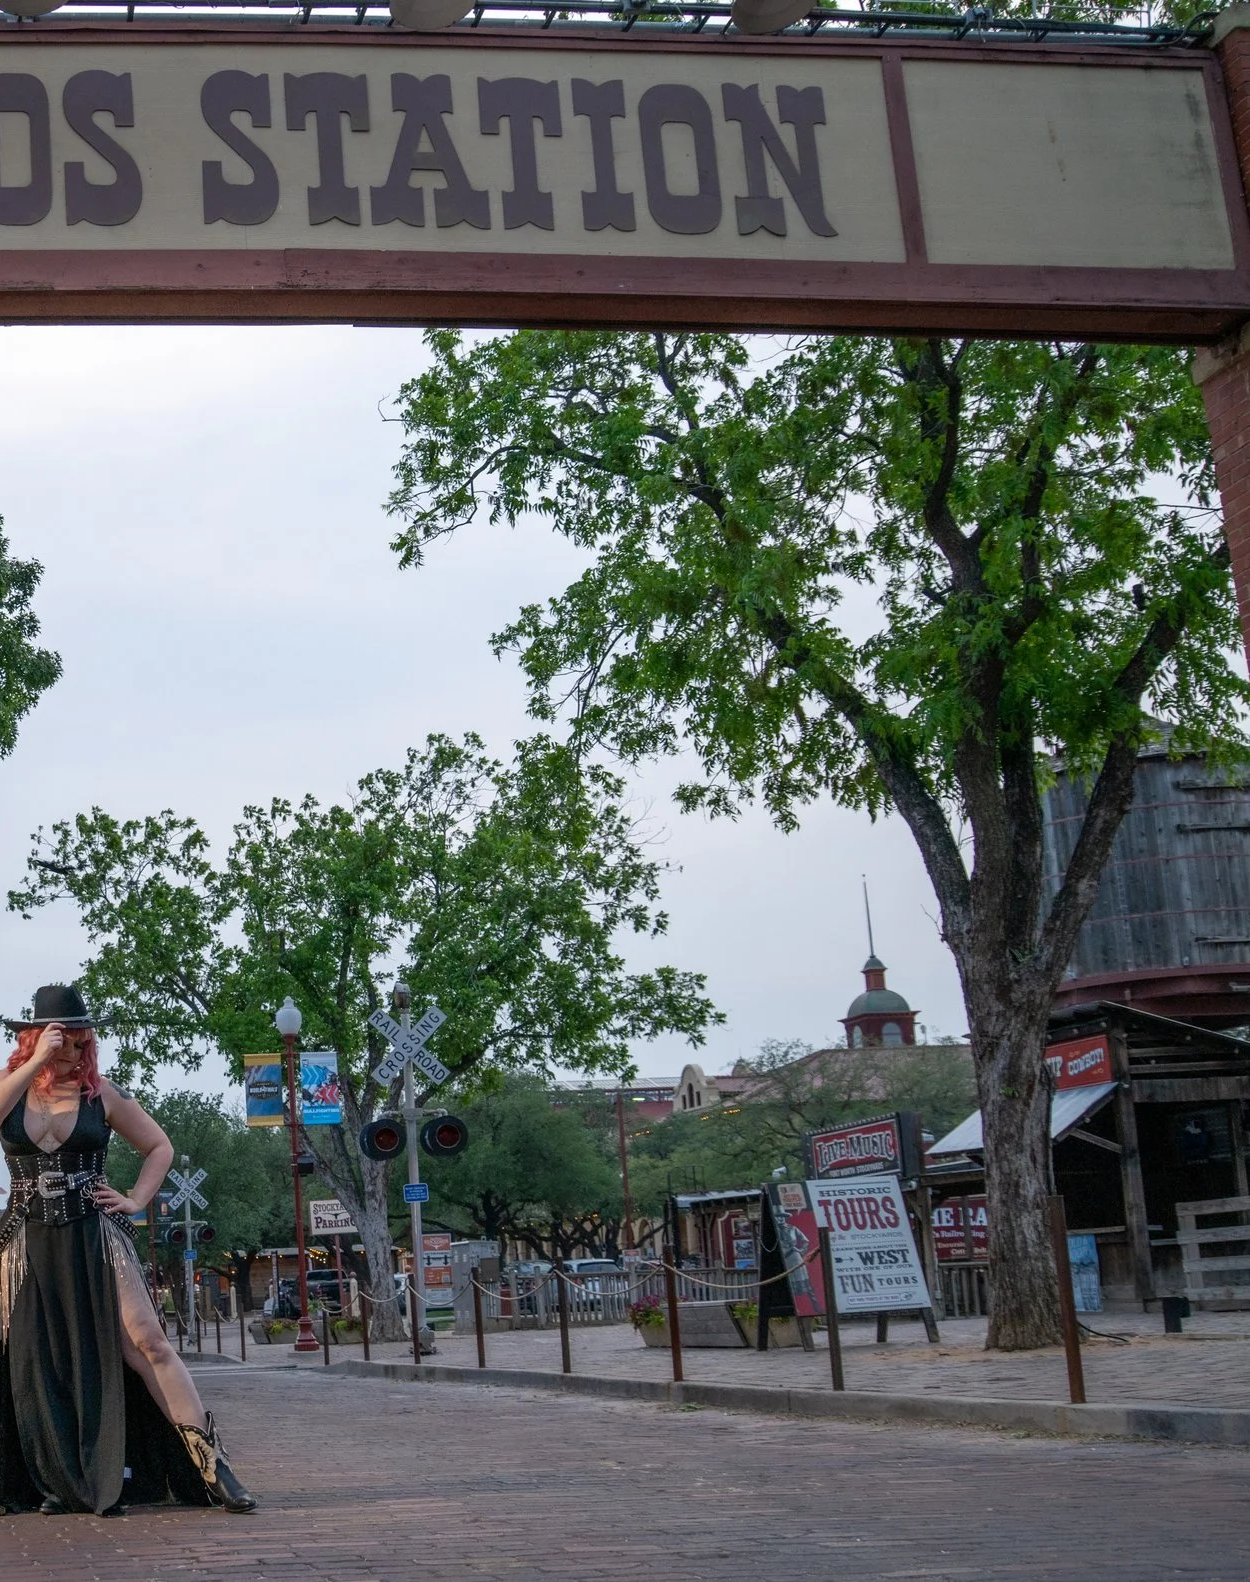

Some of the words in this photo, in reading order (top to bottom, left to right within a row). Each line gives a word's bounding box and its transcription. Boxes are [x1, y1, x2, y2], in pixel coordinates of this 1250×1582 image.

[200, 69, 839, 238] STATION
[371, 1011, 400, 1042] RAIL
[413, 1050, 446, 1081] ROAD
[815, 1139, 848, 1173] LIVE
[846, 1130, 895, 1161] MUSIC
[169, 1170, 184, 1187] RAIL
[190, 1190, 207, 1207] ROAD
[818, 1186, 892, 1197] HISTORIC
[817, 1195, 900, 1233] TOURS
[850, 1231, 903, 1241] STOCKYARDS
[856, 1248, 910, 1266] WEST
[838, 1273, 876, 1294] FUN
[878, 1276, 918, 1287] TOURS
